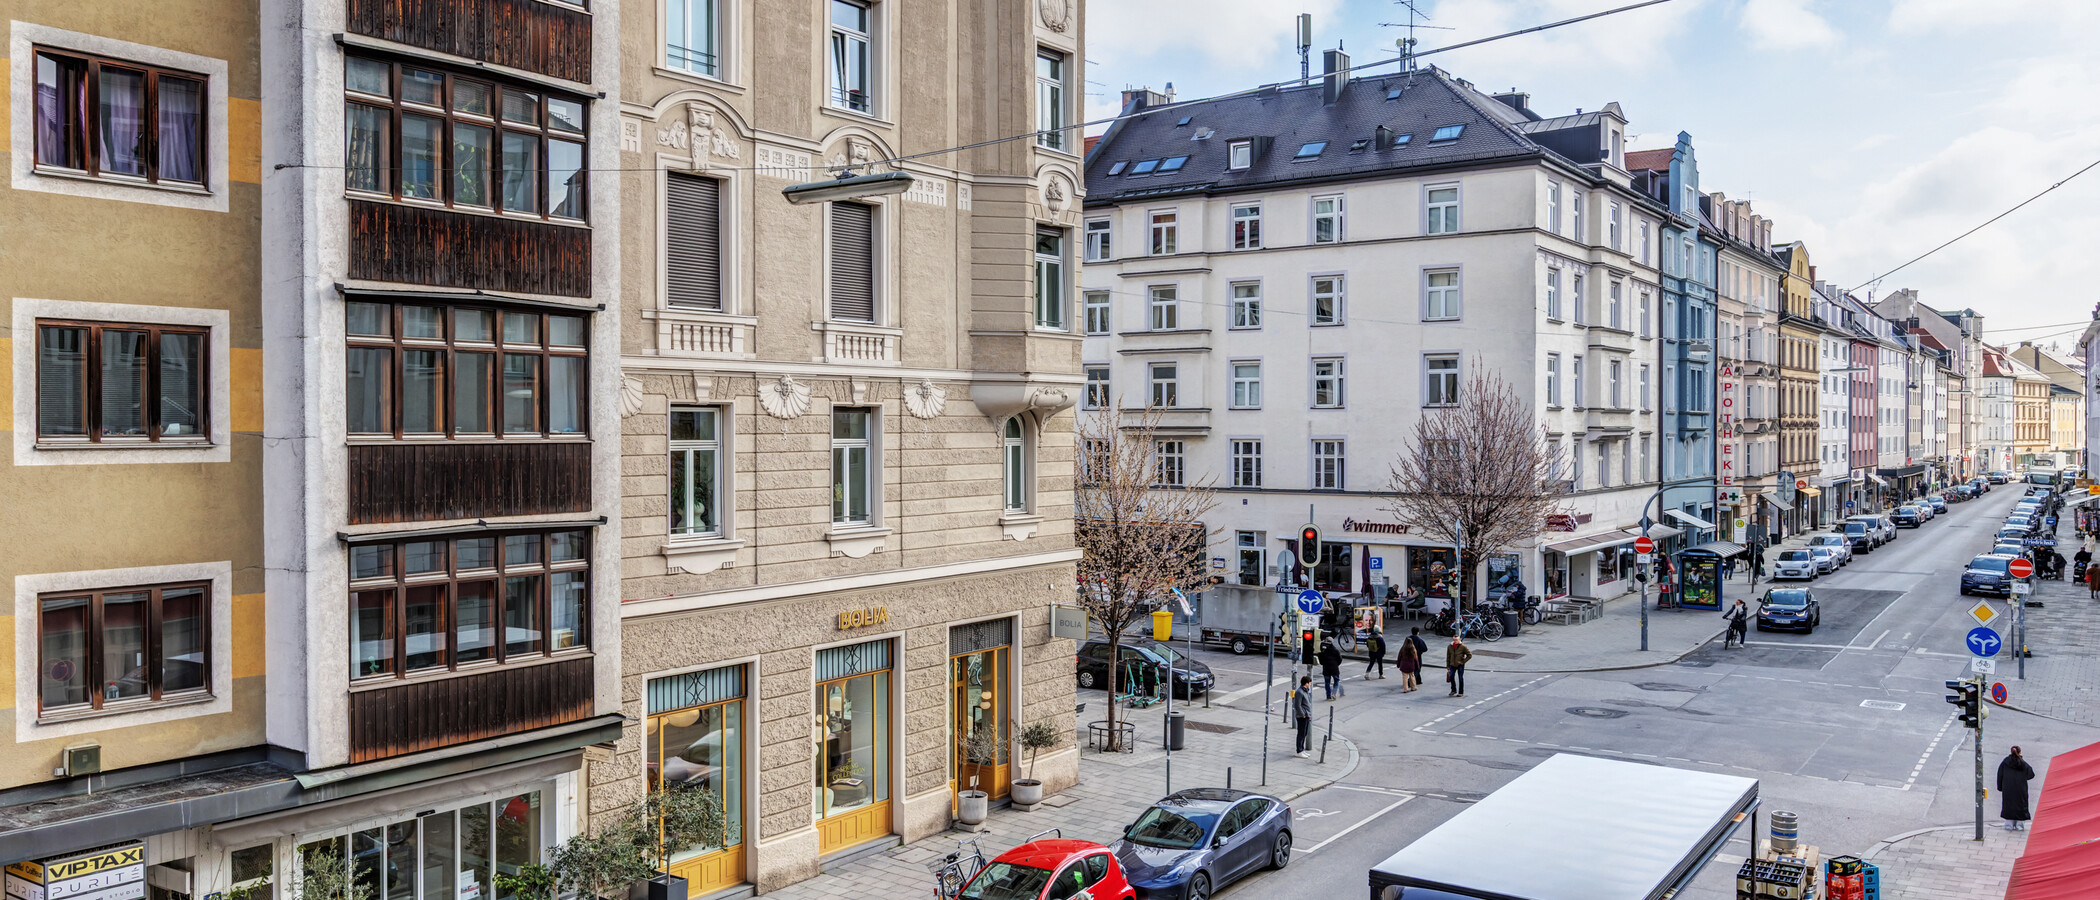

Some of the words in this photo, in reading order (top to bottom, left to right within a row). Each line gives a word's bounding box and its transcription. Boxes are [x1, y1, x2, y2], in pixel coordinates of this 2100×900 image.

[1723, 367, 1733, 485] APOTHEKE
[1353, 519, 1410, 534] wimmer
[1371, 558, 1379, 568] P
[839, 606, 888, 630] BOLIA
[1059, 620, 1082, 628] BOLIA
[108, 888, 141, 899] STUDIO
